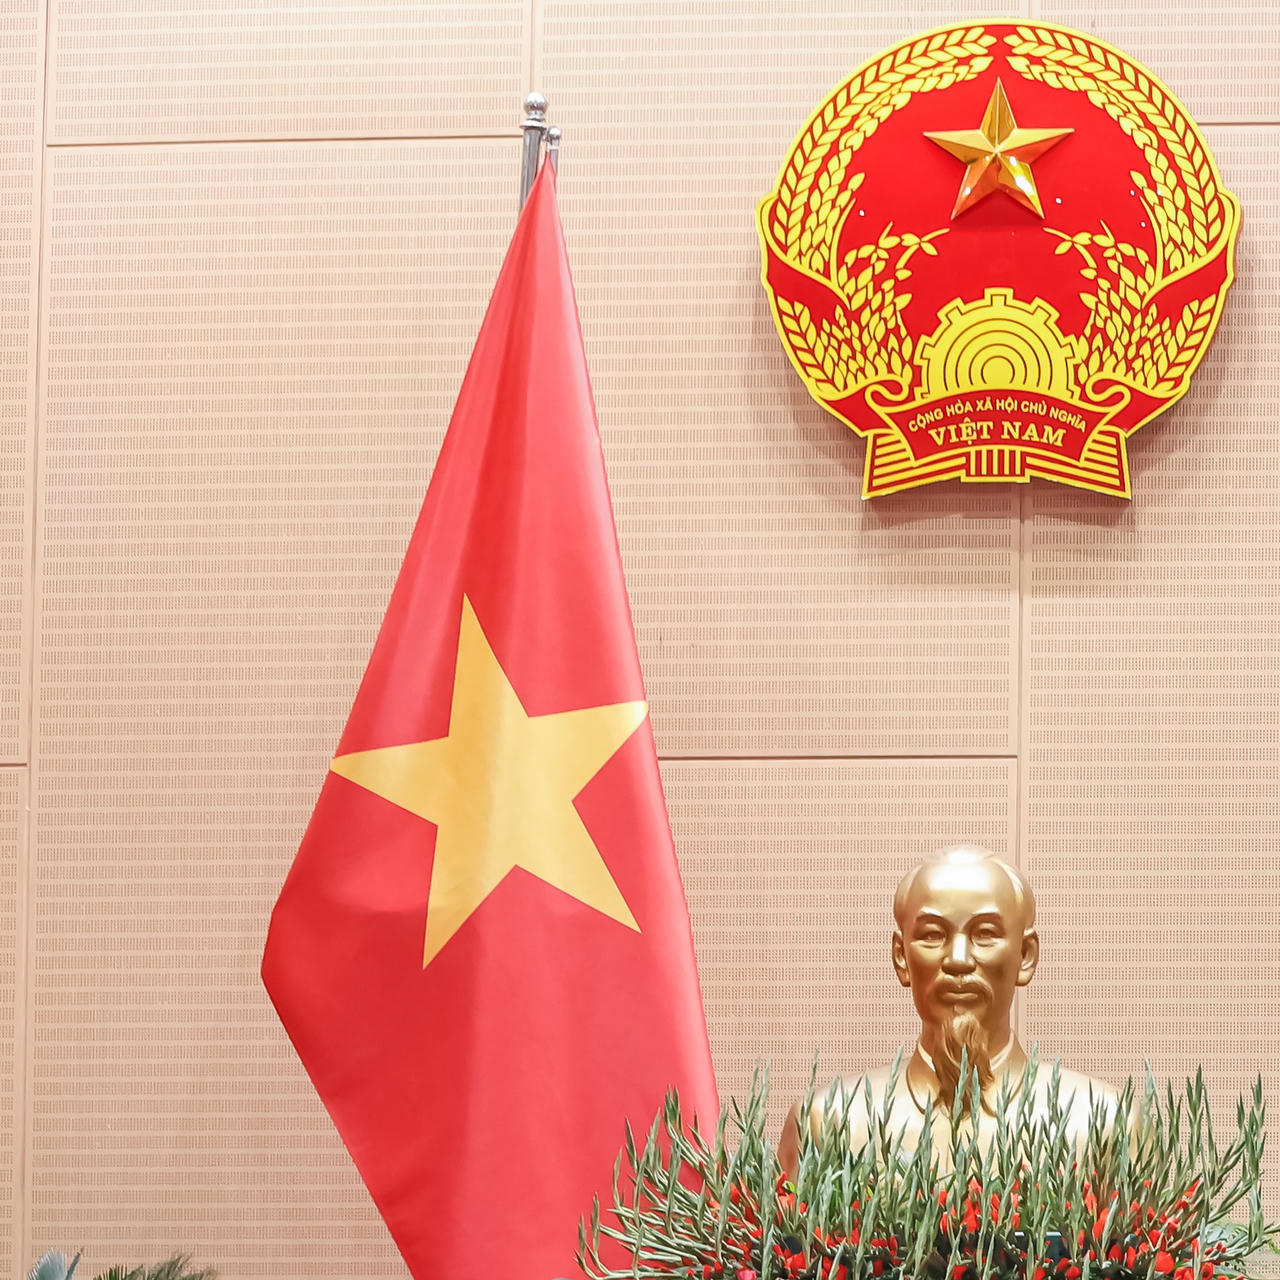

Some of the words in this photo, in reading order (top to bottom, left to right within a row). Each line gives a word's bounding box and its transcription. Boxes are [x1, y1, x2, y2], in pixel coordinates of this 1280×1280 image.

[908, 406, 944, 433] CỘNG
[946, 400, 973, 418] HÒA
[975, 396, 993, 412] XÃ
[996, 396, 1018, 414] HỘI
[1020, 399, 1048, 417] CHỦ
[1048, 405, 1088, 433] NGHĨA
[928, 418, 994, 447] VIỆT
[1001, 420, 1067, 448] NAM
